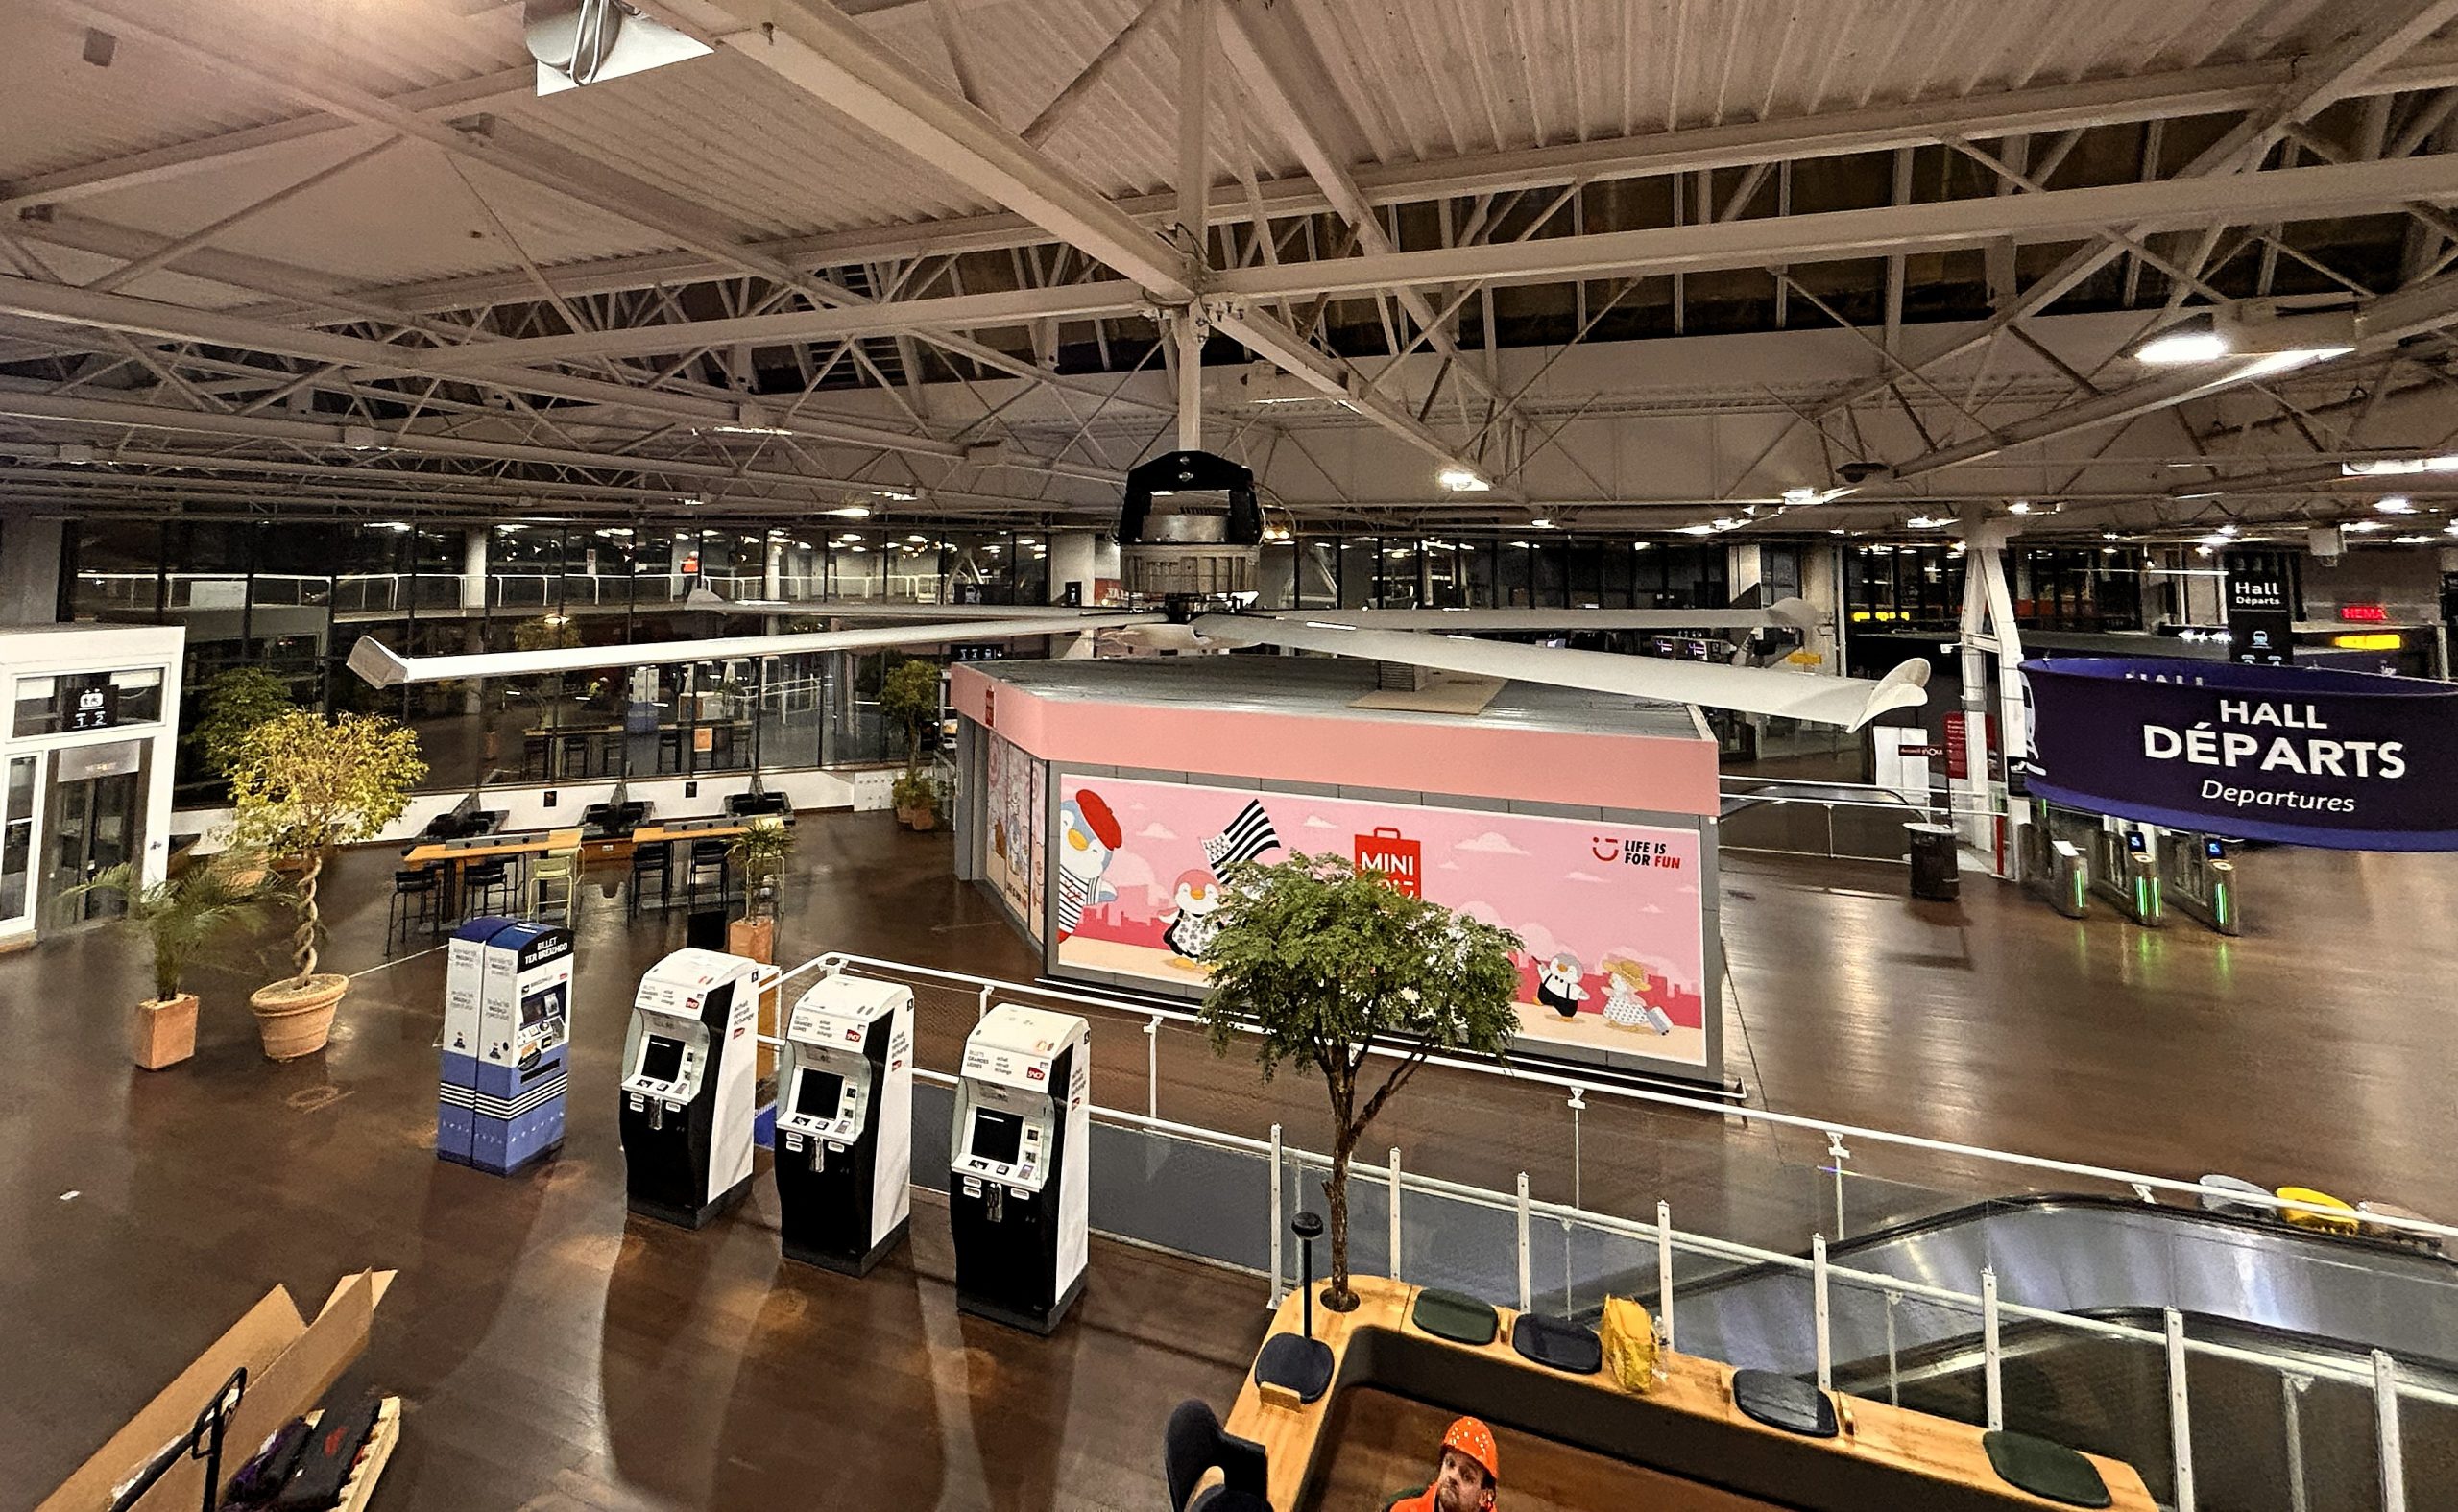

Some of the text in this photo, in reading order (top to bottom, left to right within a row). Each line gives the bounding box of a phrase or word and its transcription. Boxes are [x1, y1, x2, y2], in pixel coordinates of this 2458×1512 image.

[2235, 581, 2279, 596] Hall
[2235, 596, 2280, 607] Départs
[95, 715, 104, 724] 2
[2220, 699, 2327, 729] HALL
[2143, 722, 2406, 779] DÉPARTS
[2201, 780, 2355, 812] Departures
[1624, 839, 1667, 854] LIFE IS
[1361, 851, 1414, 876] MINI
[1624, 852, 1681, 869] FOR FUN
[537, 936, 558, 951] BILLET
[524, 955, 538, 965] TER
